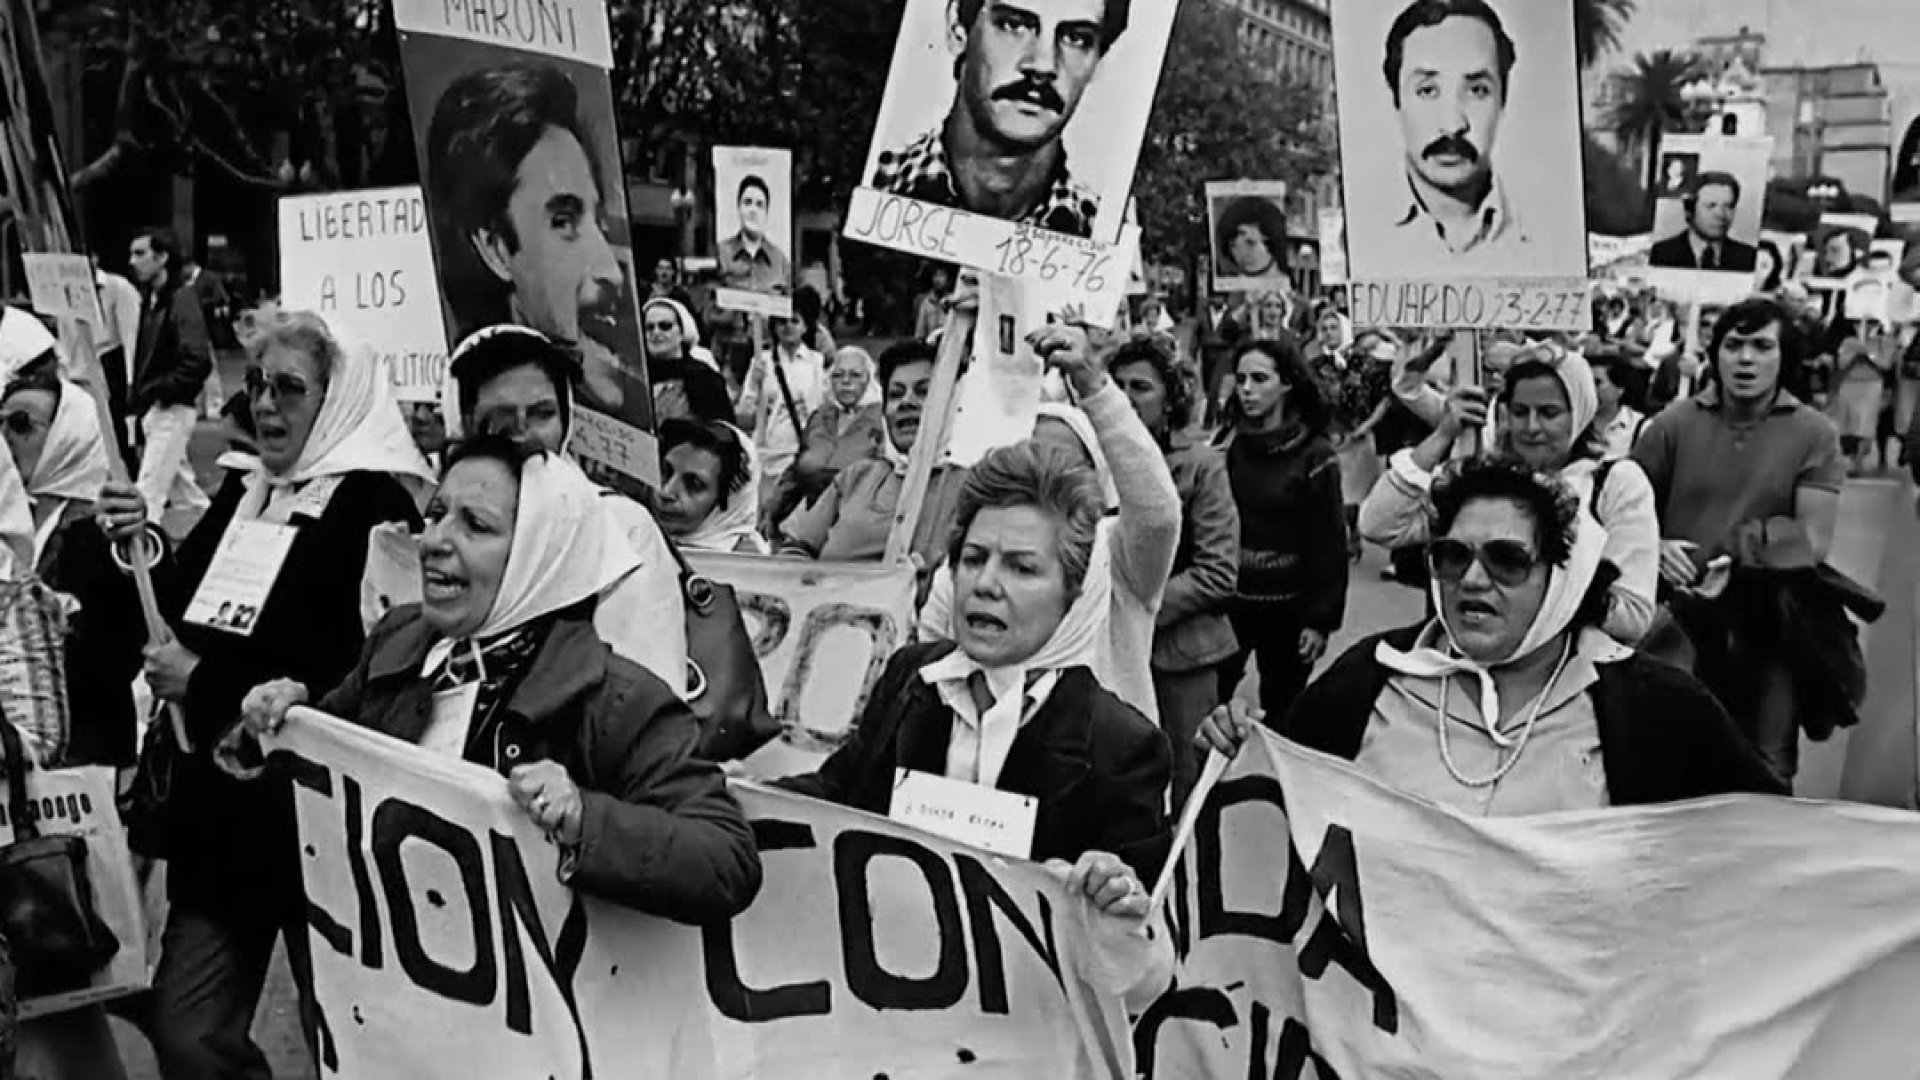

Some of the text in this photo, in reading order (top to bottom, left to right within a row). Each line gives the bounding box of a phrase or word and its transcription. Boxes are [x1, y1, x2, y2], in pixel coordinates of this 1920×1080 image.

[444, 0, 576, 51] MARONI
[300, 198, 425, 242] LIBERTAD
[855, 196, 969, 256] JORGE
[996, 237, 1112, 292] 18-6-76
[321, 270, 405, 310] A LOS
[1352, 283, 1484, 324] EDUARDO
[383, 350, 447, 386] OLITICO
[701, 818, 1069, 1023] CON
[1163, 774, 1397, 1036] IDA
